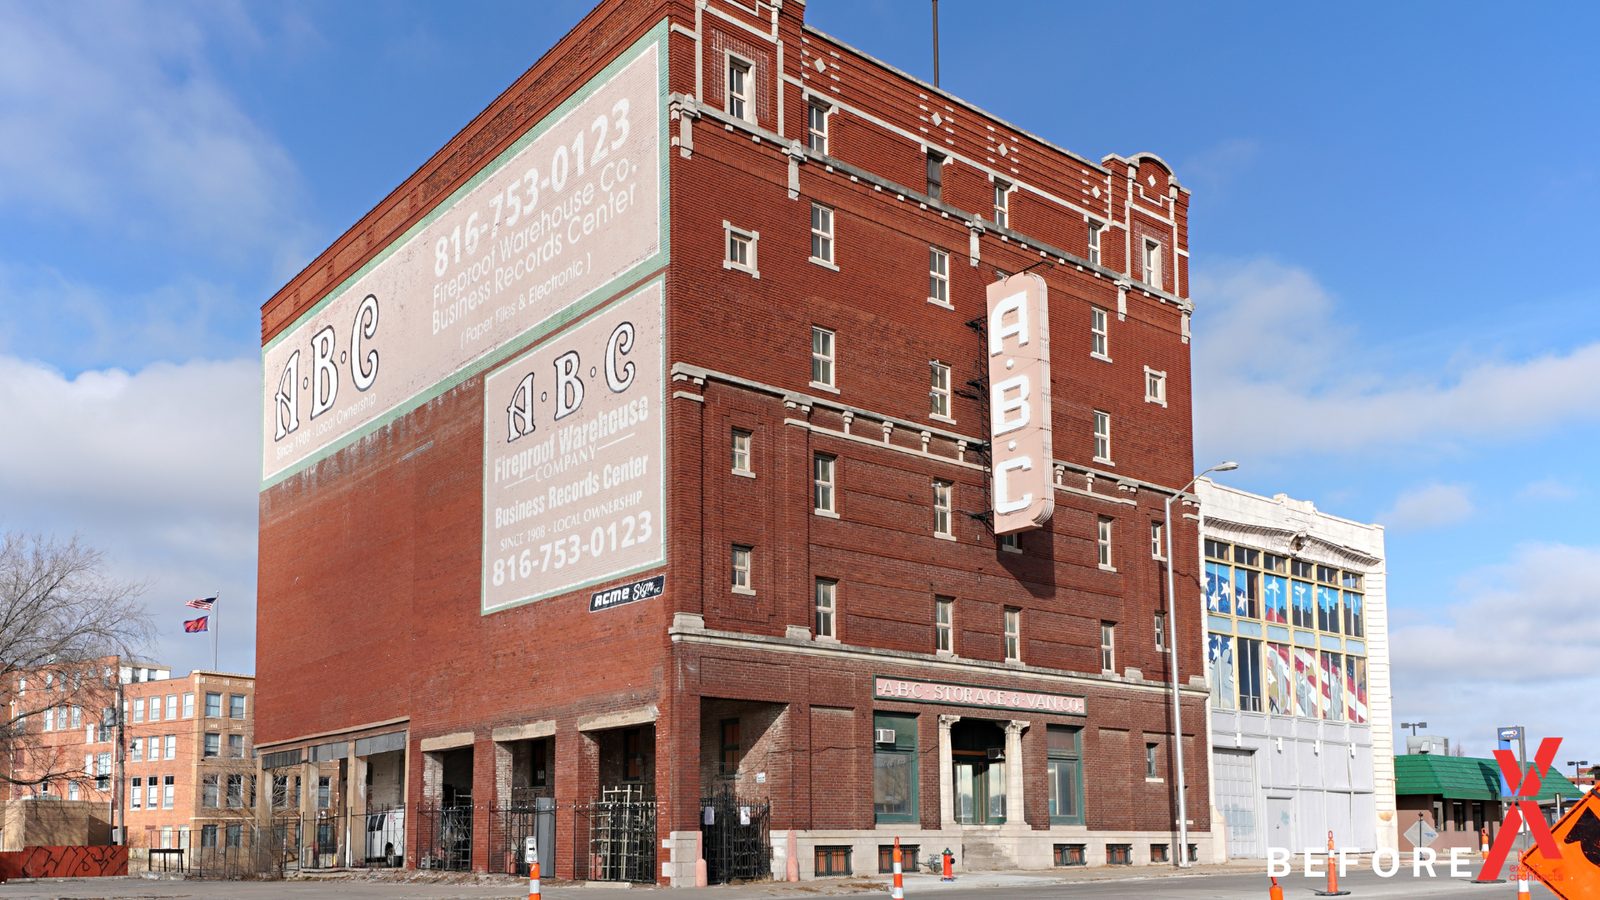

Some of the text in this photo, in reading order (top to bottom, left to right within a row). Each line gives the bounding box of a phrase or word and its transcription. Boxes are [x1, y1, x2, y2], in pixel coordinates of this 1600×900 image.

[434, 98, 630, 277] 816-753-0123
[432, 182, 636, 336] Business Records Center
[433, 158, 638, 308] Fireproof Warehouse Co.
[495, 306, 517, 324] Files
[518, 294, 526, 310] &
[336, 392, 377, 424] Ownership
[494, 396, 649, 483] Fireproof Warehouse
[495, 455, 649, 528] Business Records Center
[535, 443, 597, 482] COMPANY
[492, 510, 653, 586] 816-753-0123
[501, 531, 525, 551] SINCE
[527, 526, 546, 543] 1908
[553, 512, 582, 533] LOCAL
[583, 490, 643, 523] OWNERSHIP
[632, 581, 655, 601] Sign
[934, 684, 1006, 706] STORAGE
